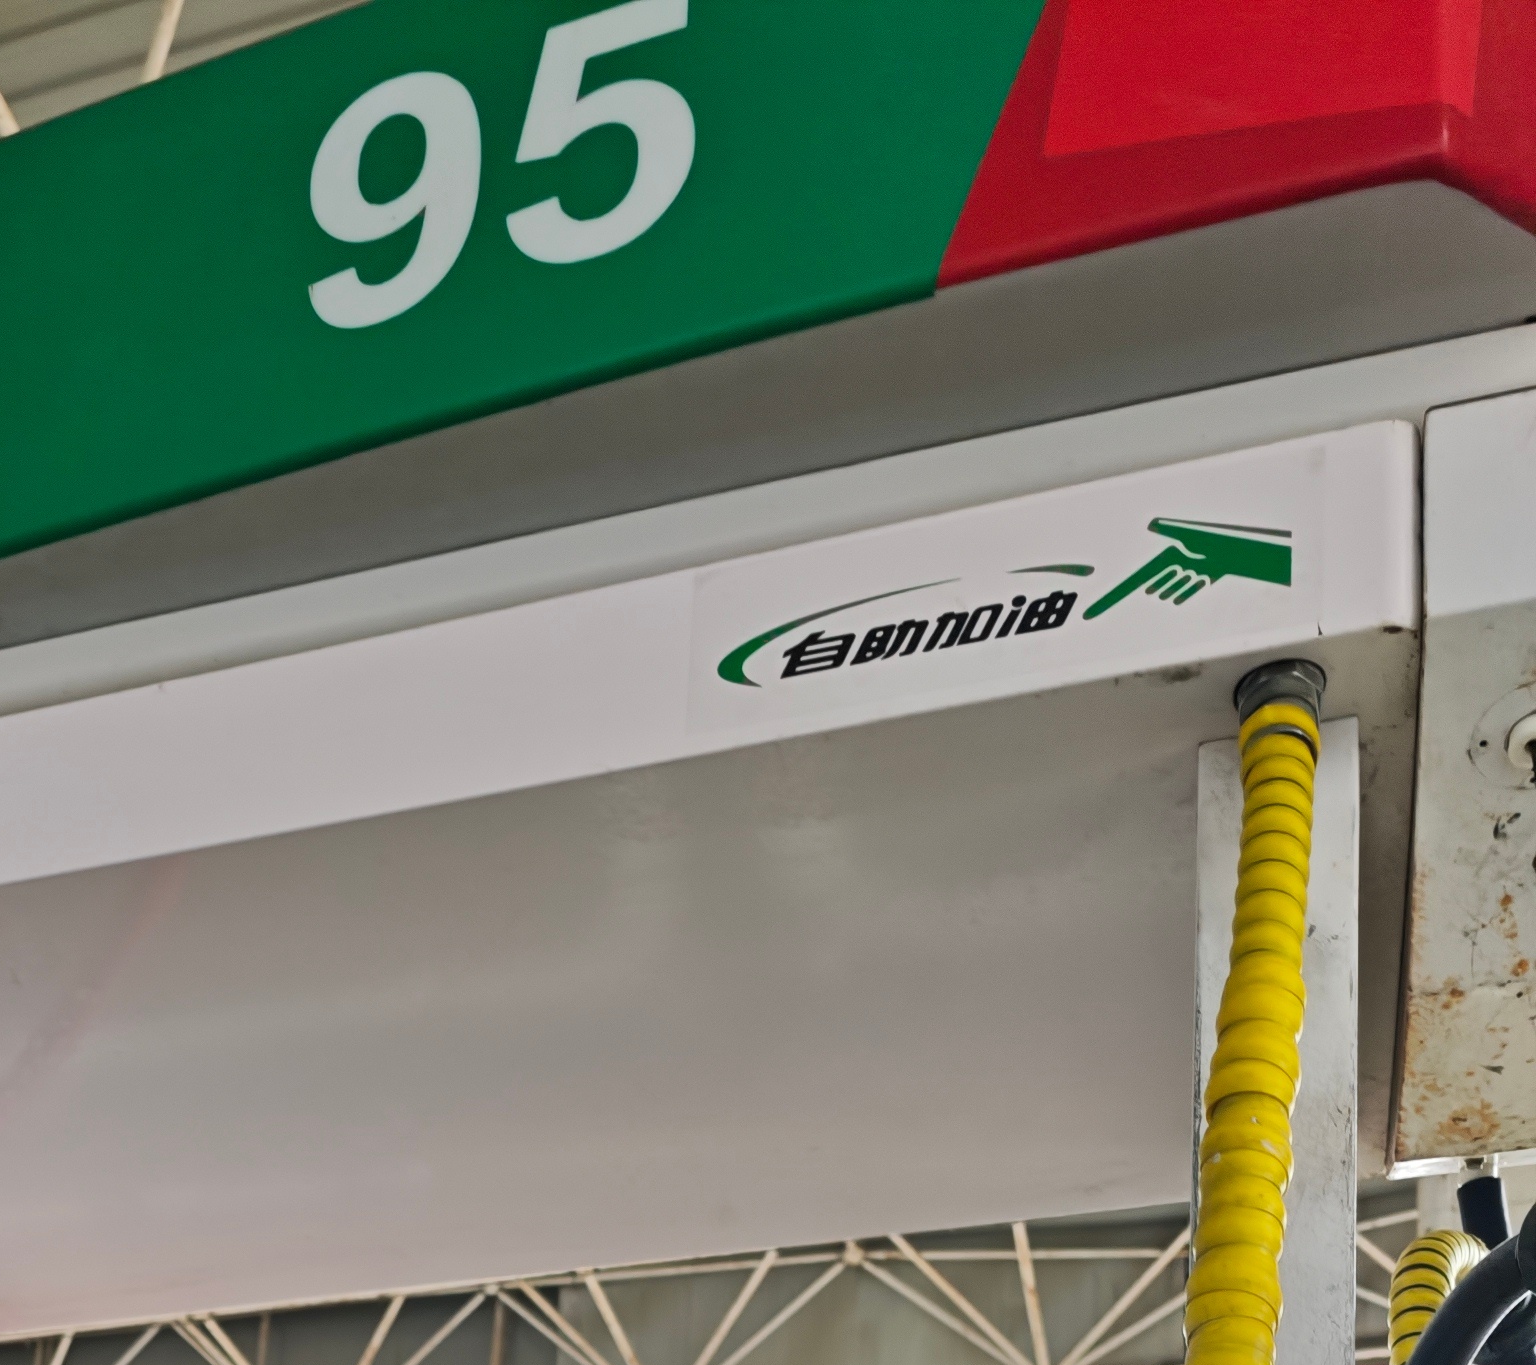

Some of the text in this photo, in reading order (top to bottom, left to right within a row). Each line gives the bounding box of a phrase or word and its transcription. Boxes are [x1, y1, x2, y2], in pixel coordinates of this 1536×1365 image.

[308, 0, 697, 330] 95
[779, 589, 1078, 681] 自助加油
